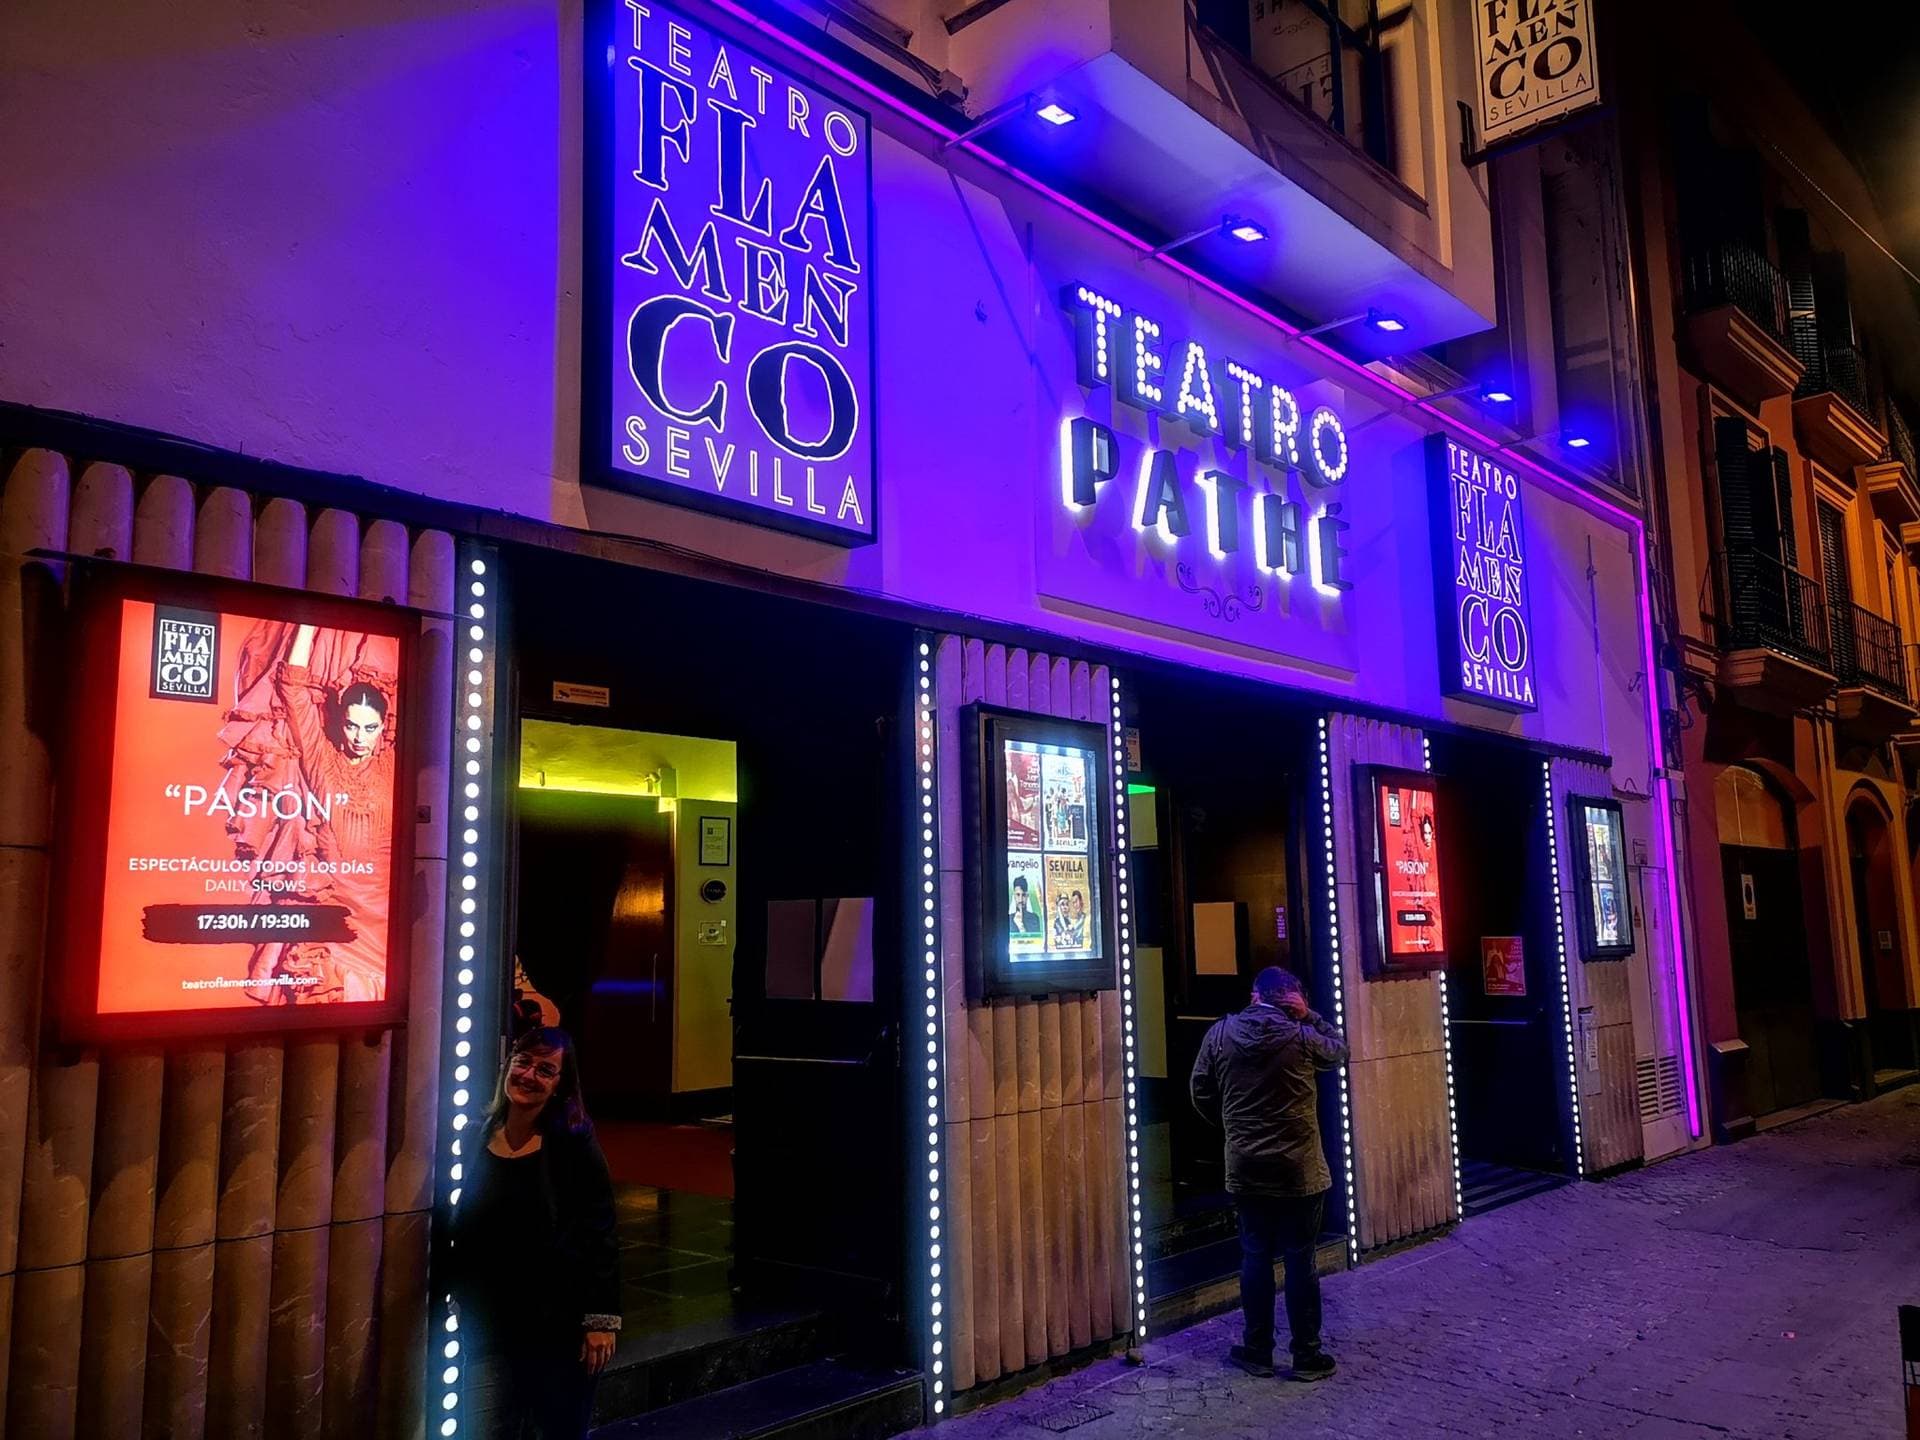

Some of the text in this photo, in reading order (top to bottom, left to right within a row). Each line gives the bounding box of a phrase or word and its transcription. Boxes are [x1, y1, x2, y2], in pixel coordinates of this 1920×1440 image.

[1486, 4, 1579, 65] MEN
[625, 0, 858, 156] TEATRO
[1489, 36, 1582, 99] CO
[1490, 72, 1586, 121] SEVILLA
[628, 57, 860, 273] FLA
[621, 198, 858, 347] MEN
[627, 295, 859, 462] CO
[1073, 279, 1349, 490] TEATRO
[622, 415, 864, 524] SEVILLA
[1448, 443, 1517, 500] TEATRO
[1451, 473, 1522, 564] FLA
[1457, 545, 1522, 606] MEN
[163, 630, 210, 654] FLA
[164, 623, 211, 636] TEATRO
[1460, 594, 1528, 672] CO
[161, 663, 208, 685] CO
[162, 682, 207, 694] SEVILLA
[1463, 661, 1534, 703] SEVILLA
[129, 856, 374, 874] ESPECTÁCULOS TODOS LOS DÍAS
[205, 879, 306, 892] DAILY SHOWS
[1049, 860, 1084, 872] SEVILLA
[197, 913, 310, 929] 17:30h / 19:30h
[182, 974, 318, 990] teatroflamencosevilla.com
